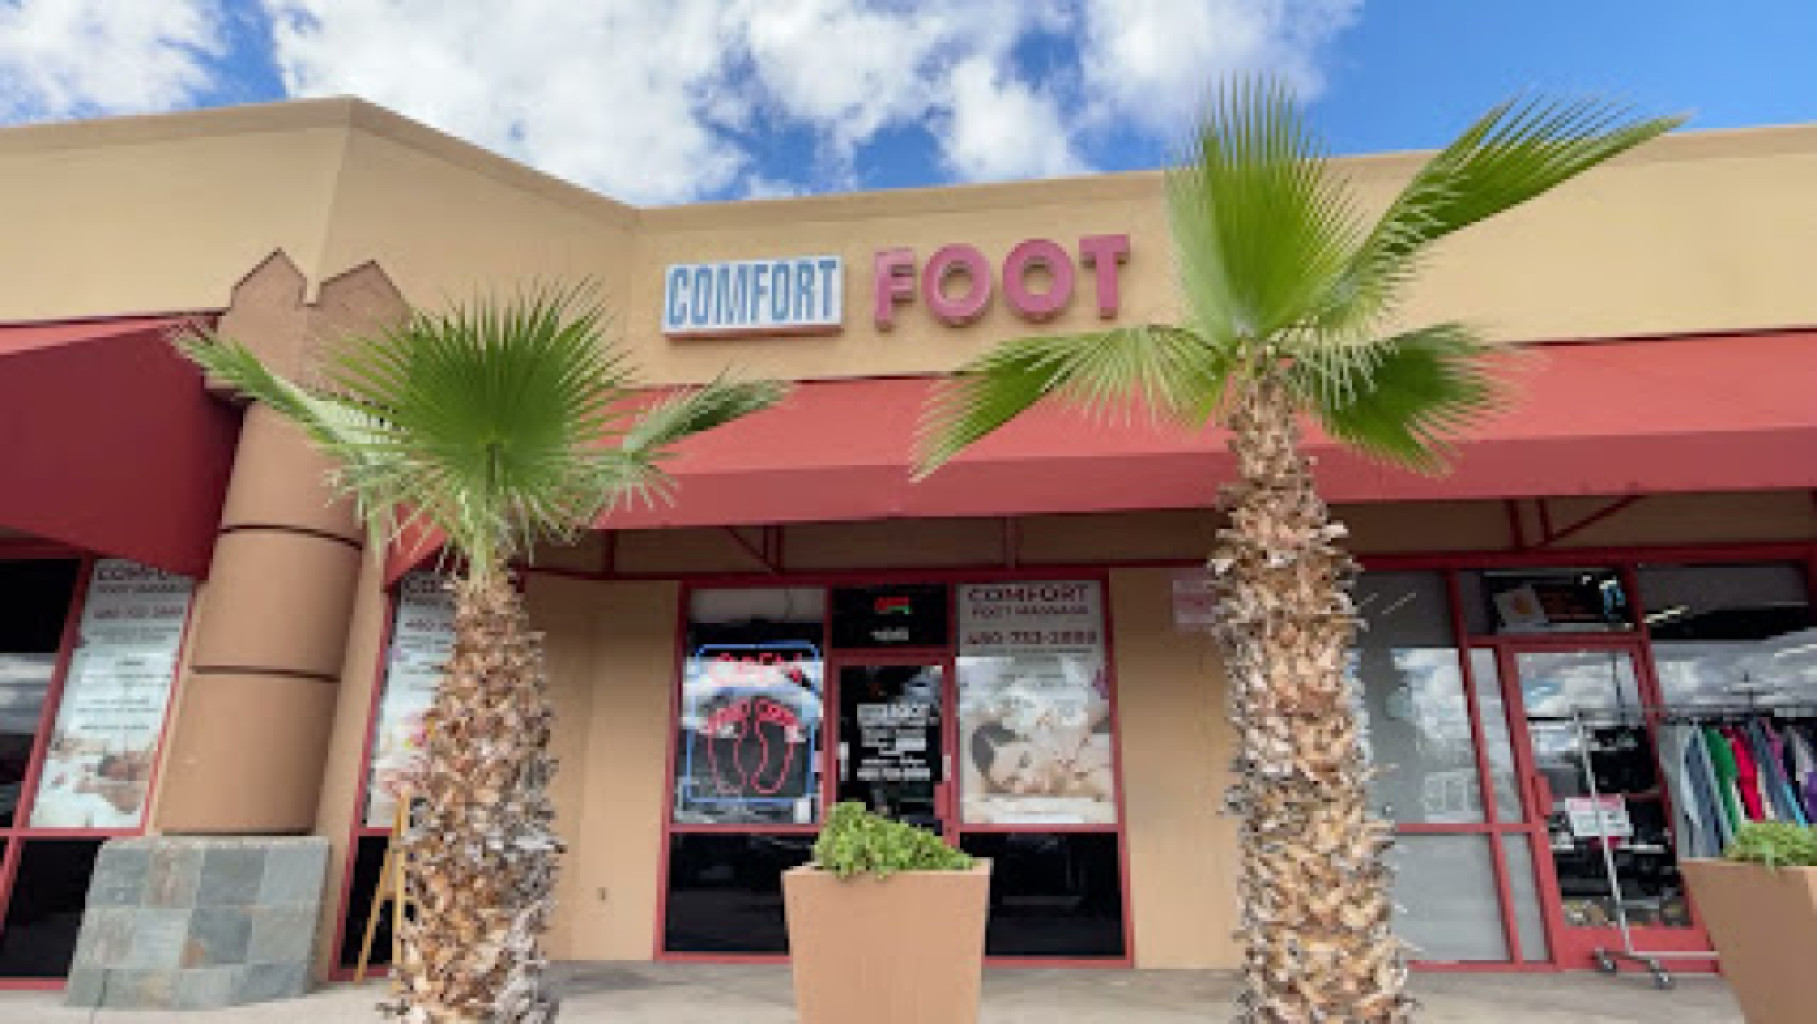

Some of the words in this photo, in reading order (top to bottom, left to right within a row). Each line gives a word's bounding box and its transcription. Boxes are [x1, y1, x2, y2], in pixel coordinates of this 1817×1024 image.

[668, 258, 837, 327] COMFORT
[874, 233, 1131, 332] FOOT
[968, 583, 1089, 603] COMFORT
